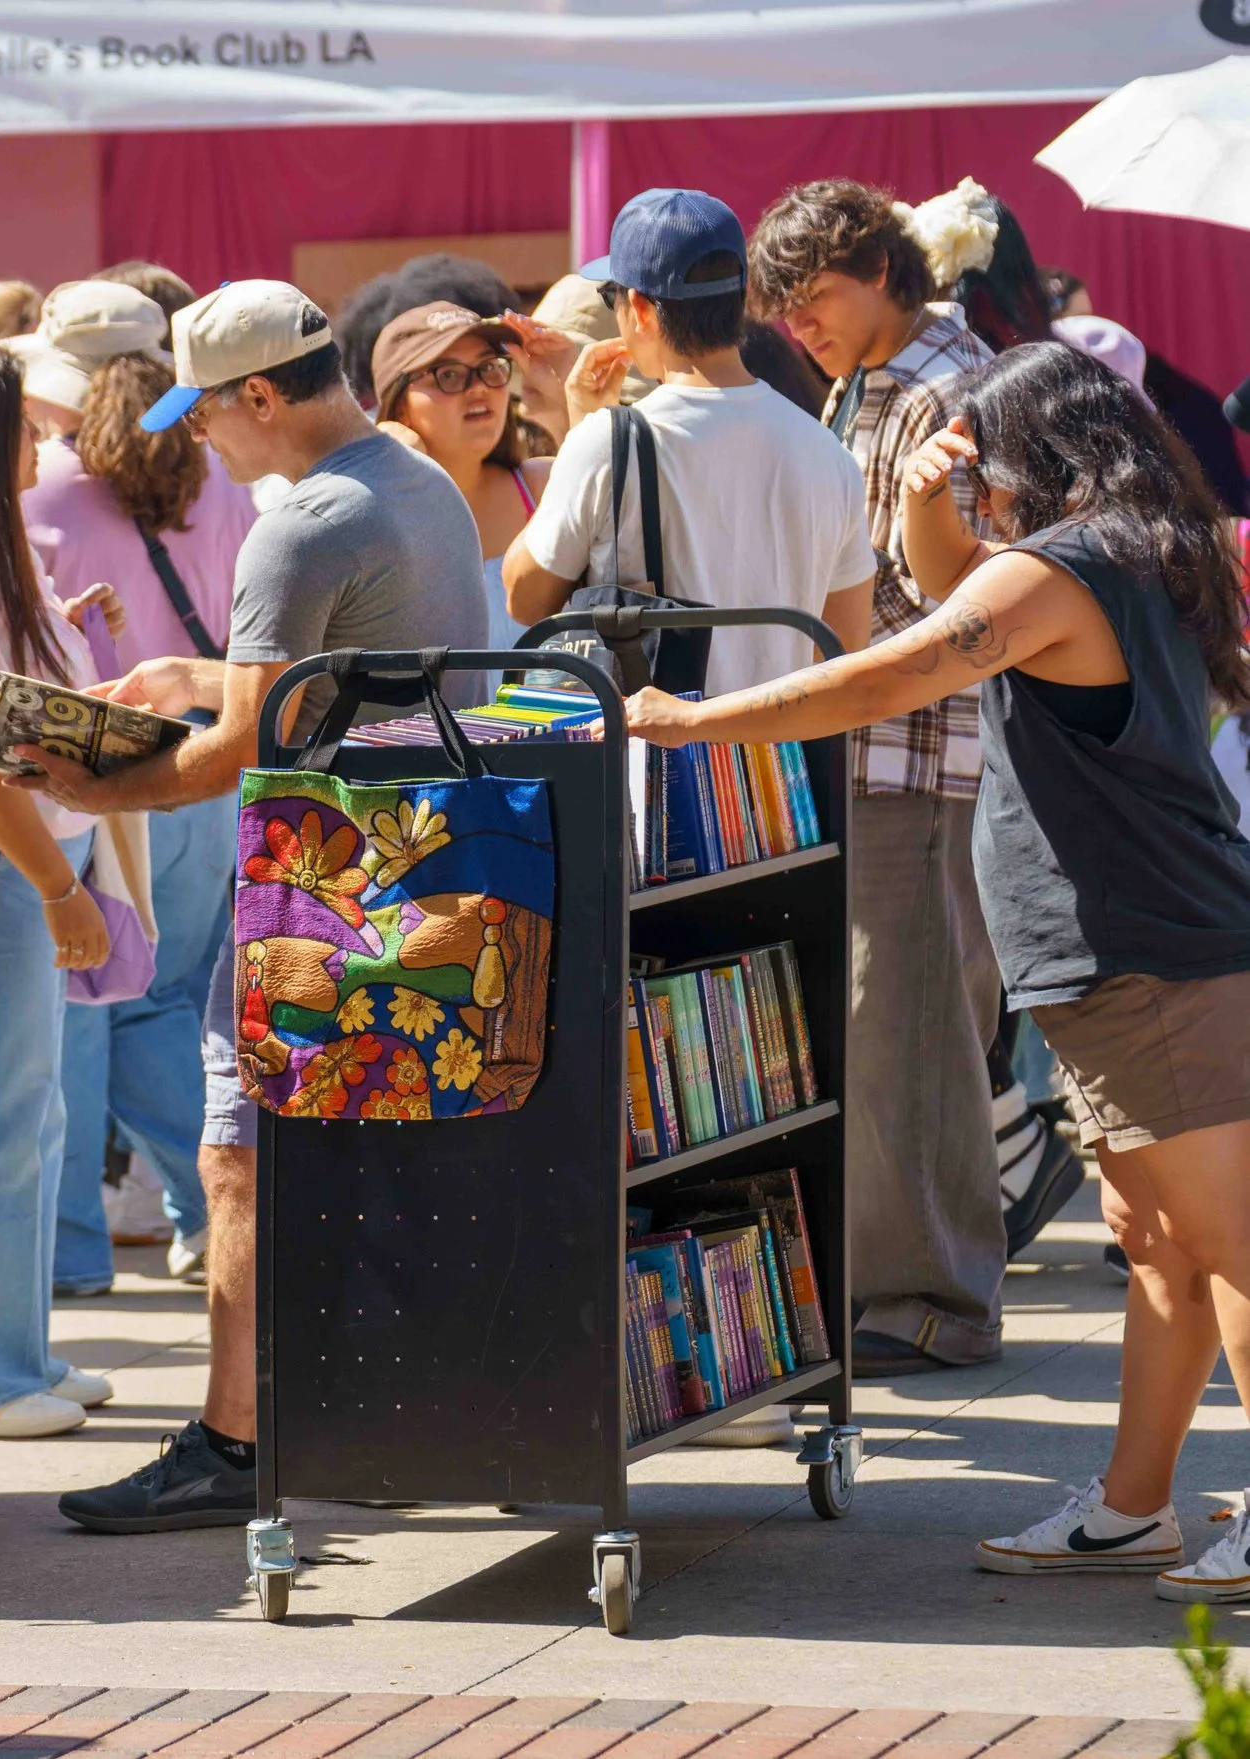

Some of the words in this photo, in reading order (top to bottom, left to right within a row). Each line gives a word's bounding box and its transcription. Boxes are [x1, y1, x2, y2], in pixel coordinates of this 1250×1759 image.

[100, 34, 201, 68] Book
[213, 30, 306, 66] Club
[319, 28, 375, 65] LA
[493, 1012, 504, 1029] Hills
[491, 1030, 503, 1060] Pamela
